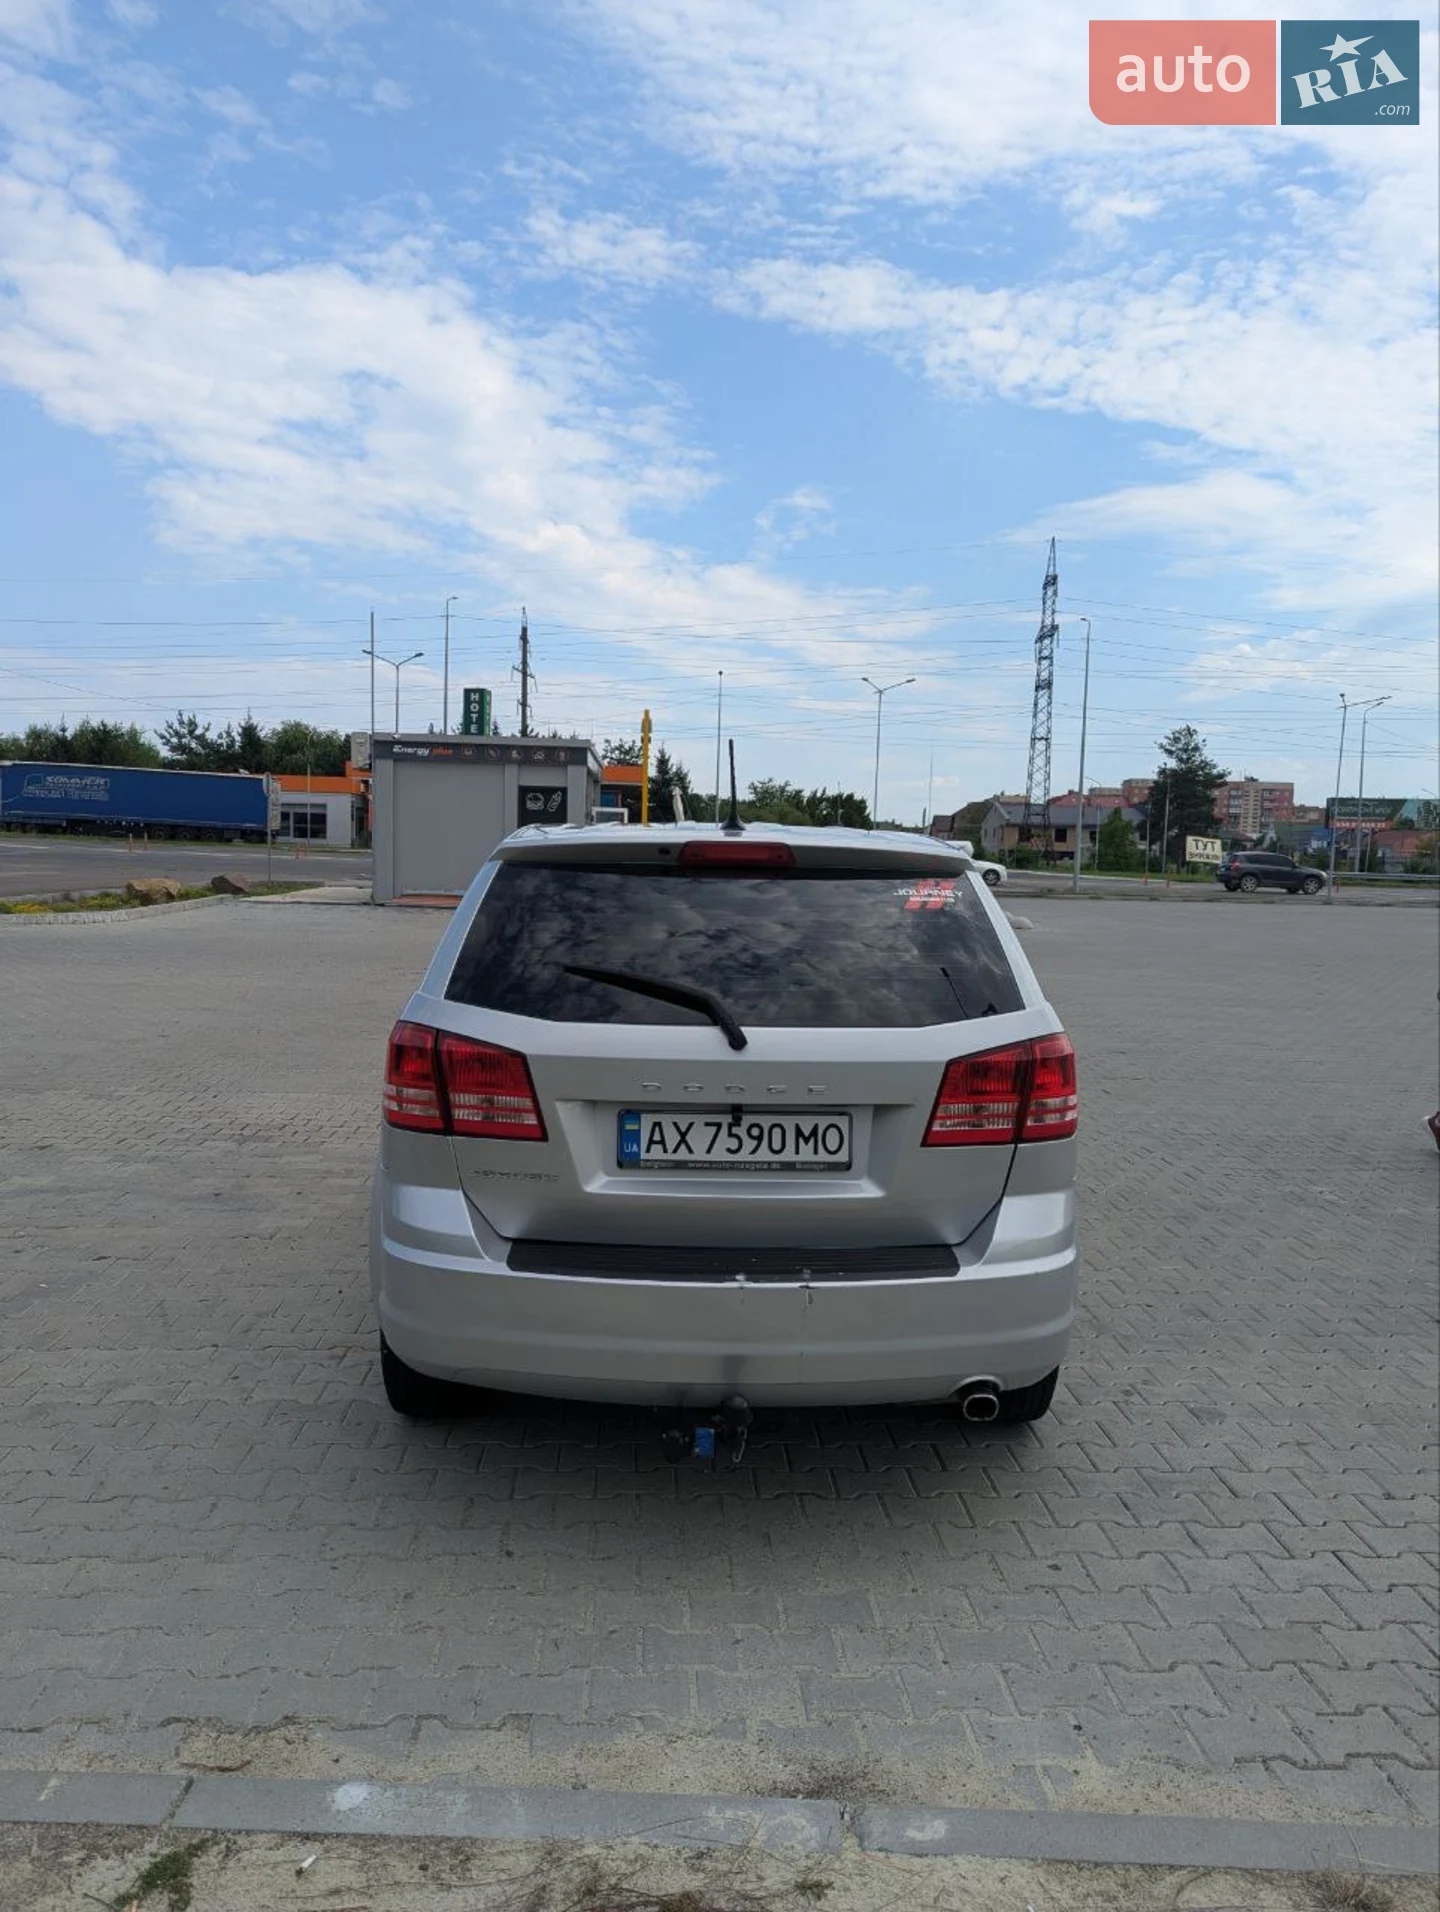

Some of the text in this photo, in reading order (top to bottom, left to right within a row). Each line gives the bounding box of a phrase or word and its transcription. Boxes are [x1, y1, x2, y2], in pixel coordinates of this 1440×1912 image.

[893, 888, 963, 898] JOURNEY
[641, 1081, 828, 1094] DODGE
[645, 1121, 845, 1156] AX 7590 MO
[623, 1144, 639, 1153] UA
